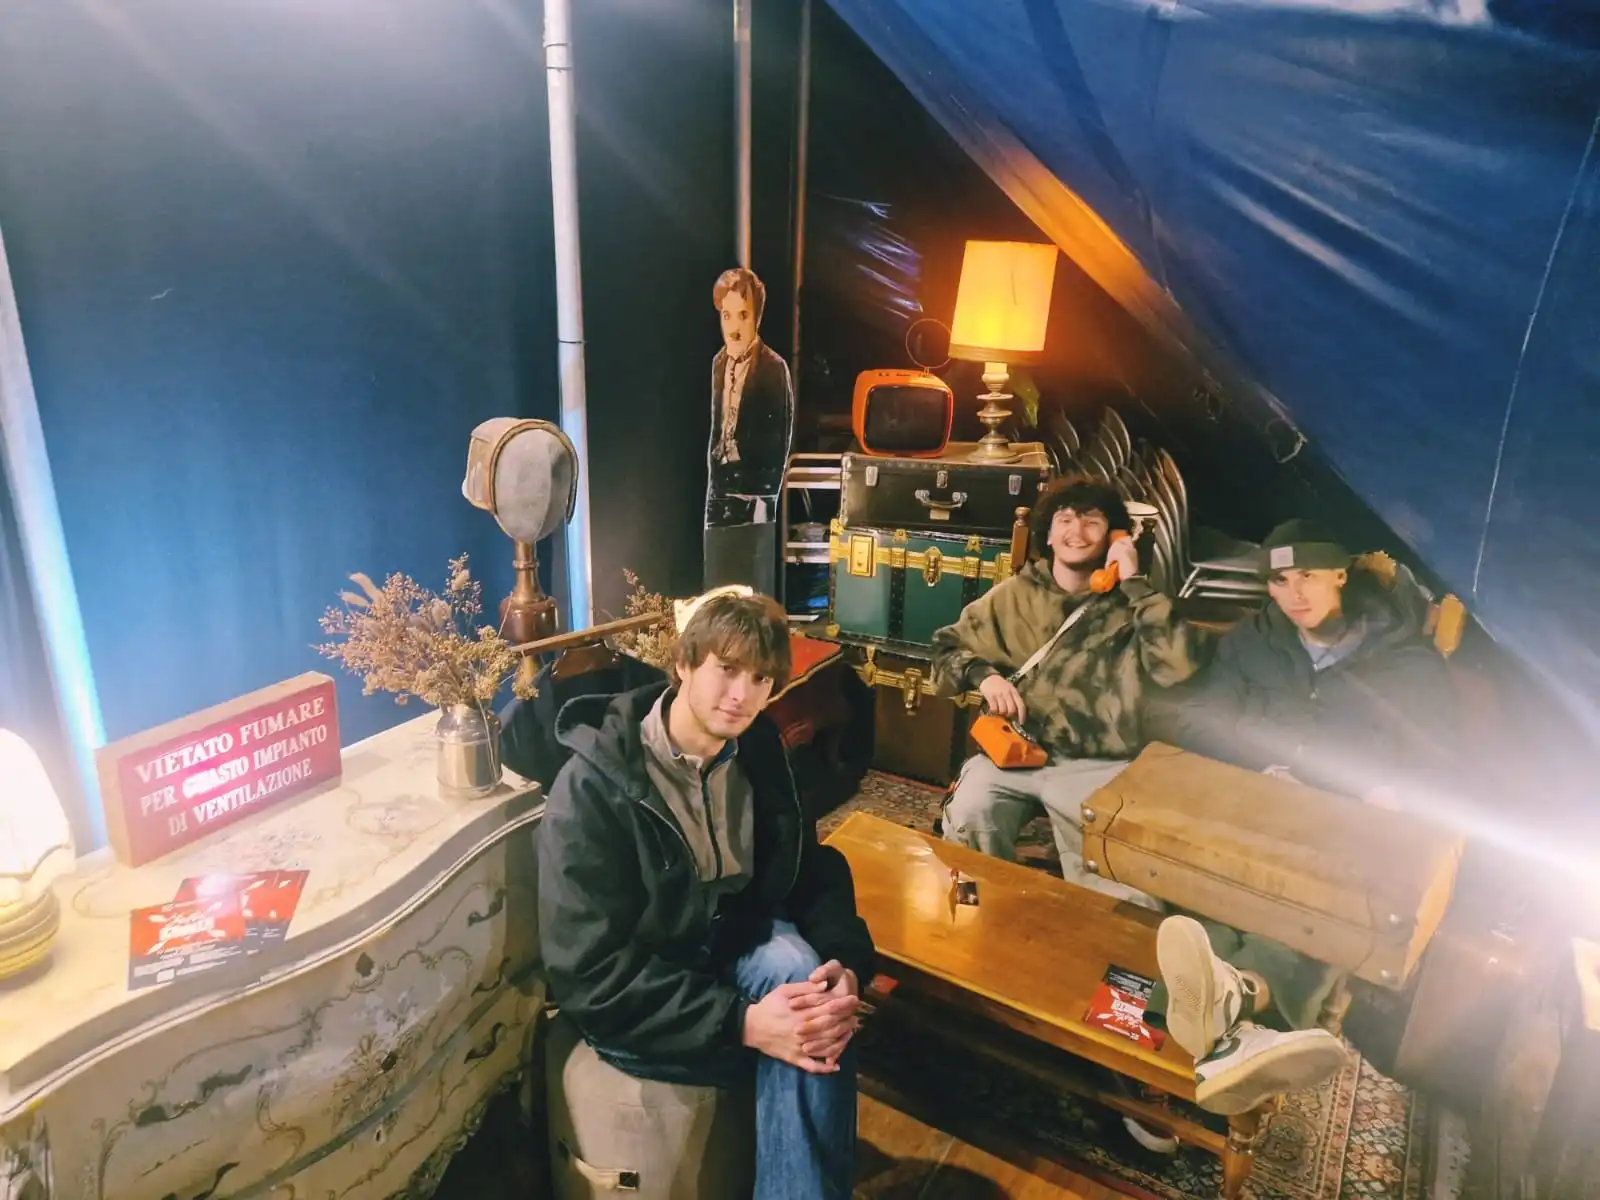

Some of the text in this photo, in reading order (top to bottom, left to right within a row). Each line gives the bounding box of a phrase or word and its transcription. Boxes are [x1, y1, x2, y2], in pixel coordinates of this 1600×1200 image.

[134, 696, 325, 784] VIETATO FUMARE
[139, 723, 327, 817] PER ASTO IMPIANTO
[168, 757, 312, 836] DI VENTILAZIONE
